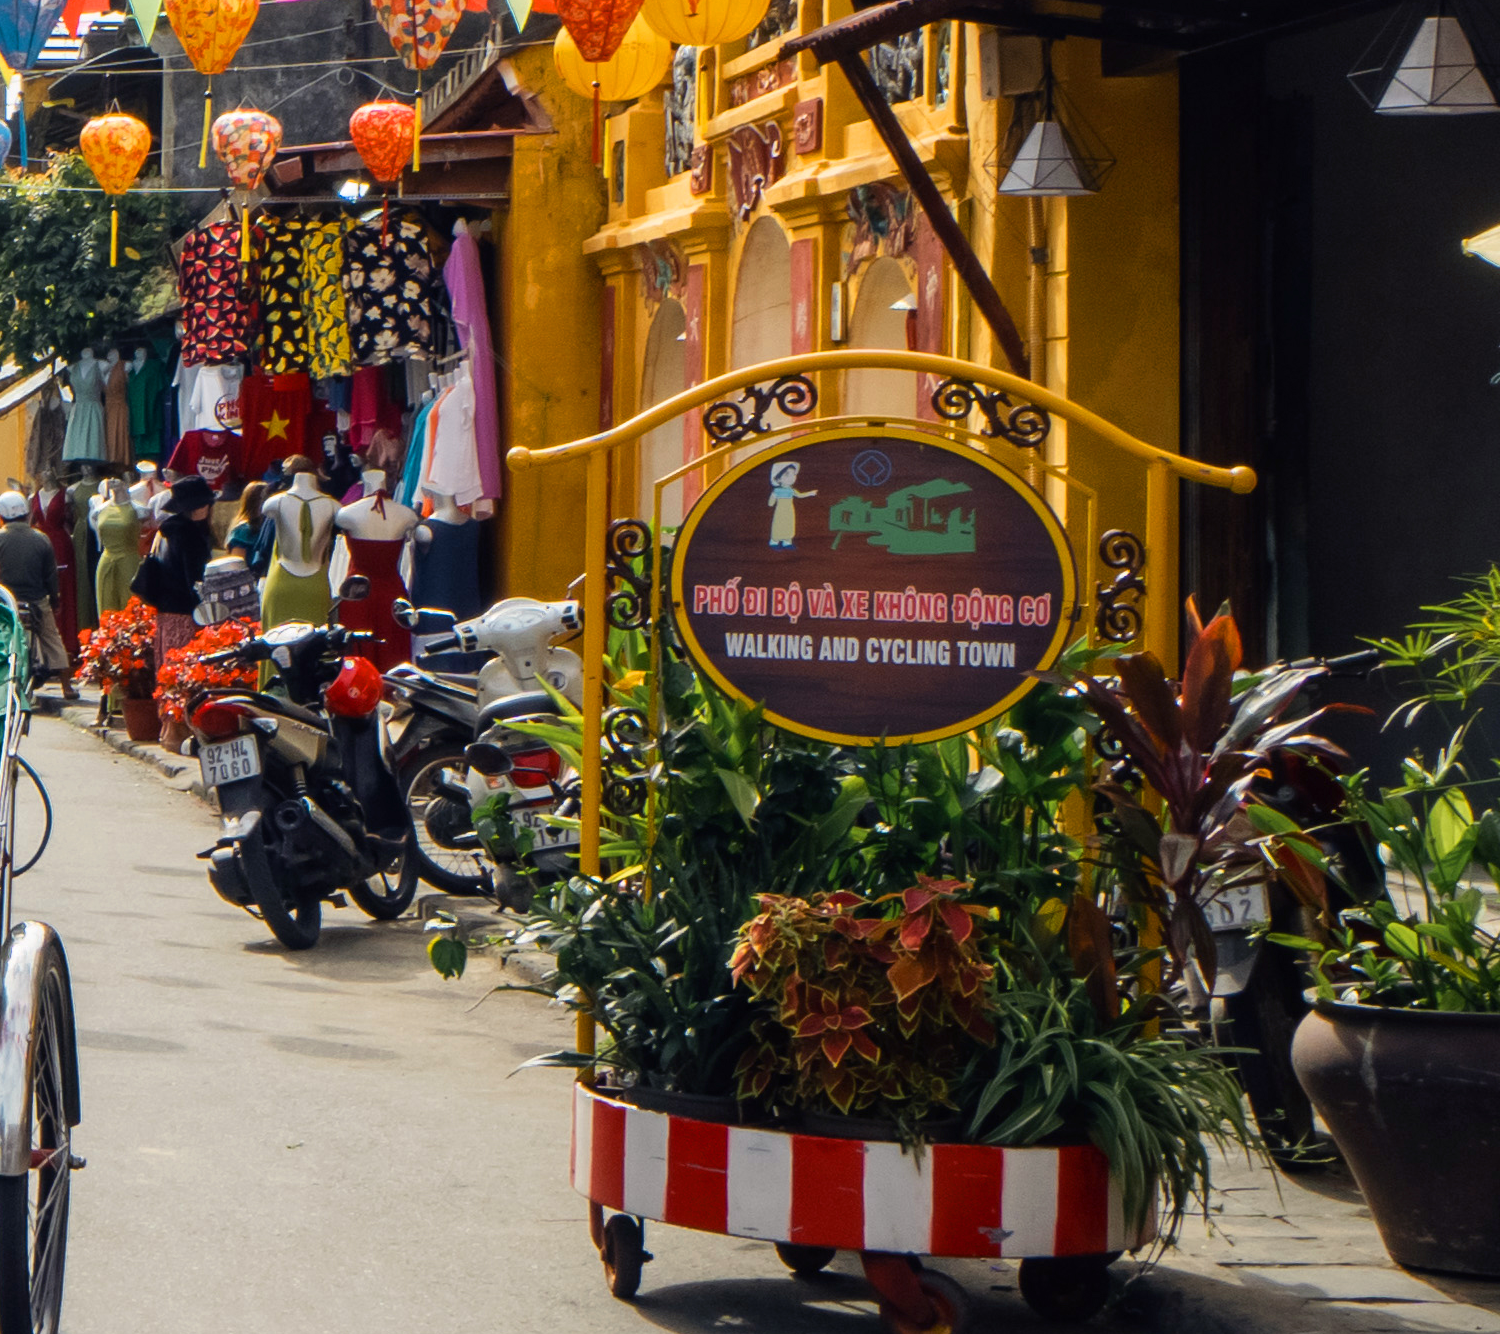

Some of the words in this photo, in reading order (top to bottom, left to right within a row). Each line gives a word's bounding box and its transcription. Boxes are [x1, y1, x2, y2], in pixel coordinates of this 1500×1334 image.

[692, 577, 740, 616] PHỐ
[742, 587, 768, 616] ĐI
[772, 581, 803, 625] BỘ
[805, 581, 838, 620] VÀ
[840, 591, 870, 622] XE
[871, 584, 950, 624] KHÔNG
[950, 585, 1017, 631] ĐỘNG
[1018, 592, 1052, 627] CƠ
[724, 631, 813, 661] WALKING
[818, 634, 862, 664] AND
[864, 637, 952, 666] CYCLING
[956, 640, 1017, 669] TOWN
